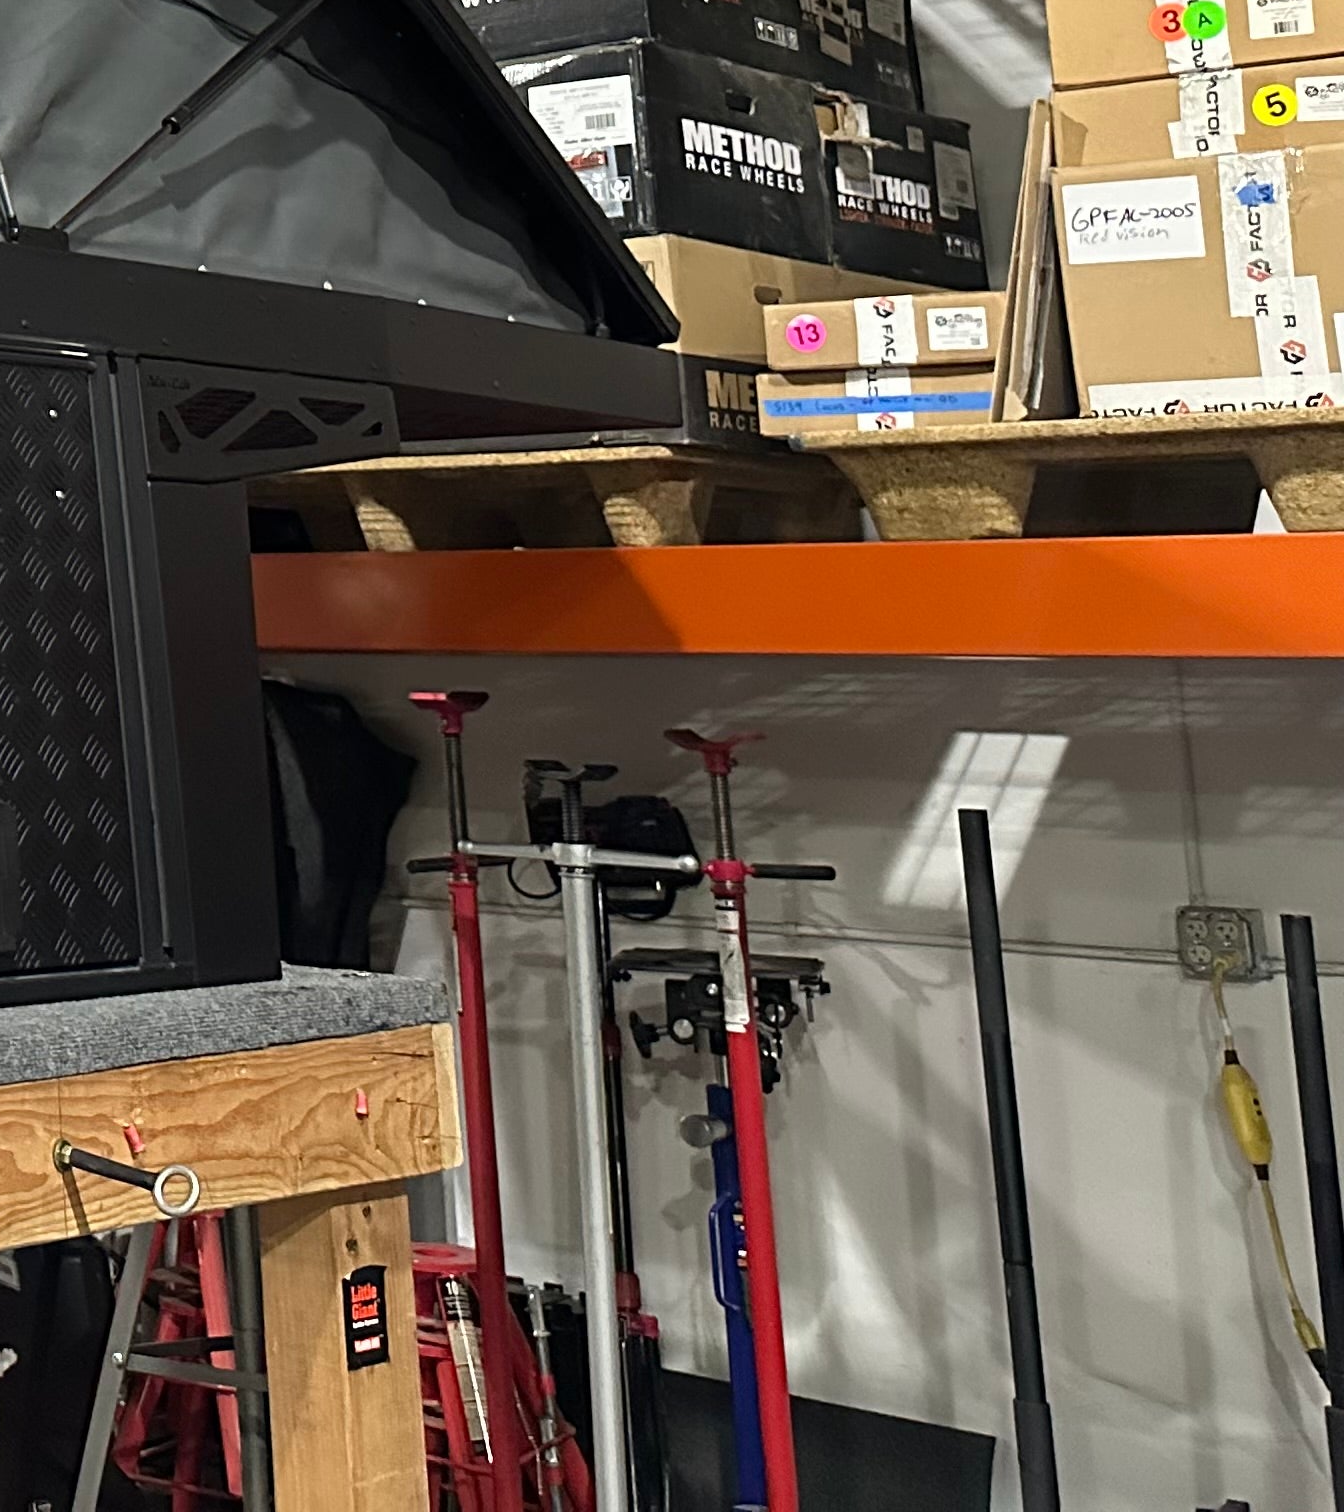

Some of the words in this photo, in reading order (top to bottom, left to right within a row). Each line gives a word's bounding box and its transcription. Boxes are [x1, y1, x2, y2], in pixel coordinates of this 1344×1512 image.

[1162, 9, 1181, 34] 3
[1198, 11, 1213, 29] A
[1265, 93, 1287, 118] 5
[681, 117, 802, 176] METHOD
[685, 153, 733, 178] RACE
[740, 163, 805, 194] WHEELS
[837, 194, 874, 213] RACE
[879, 201, 933, 224] WHEELS
[793, 323, 821, 346] 13
[708, 411, 759, 433] RACE
